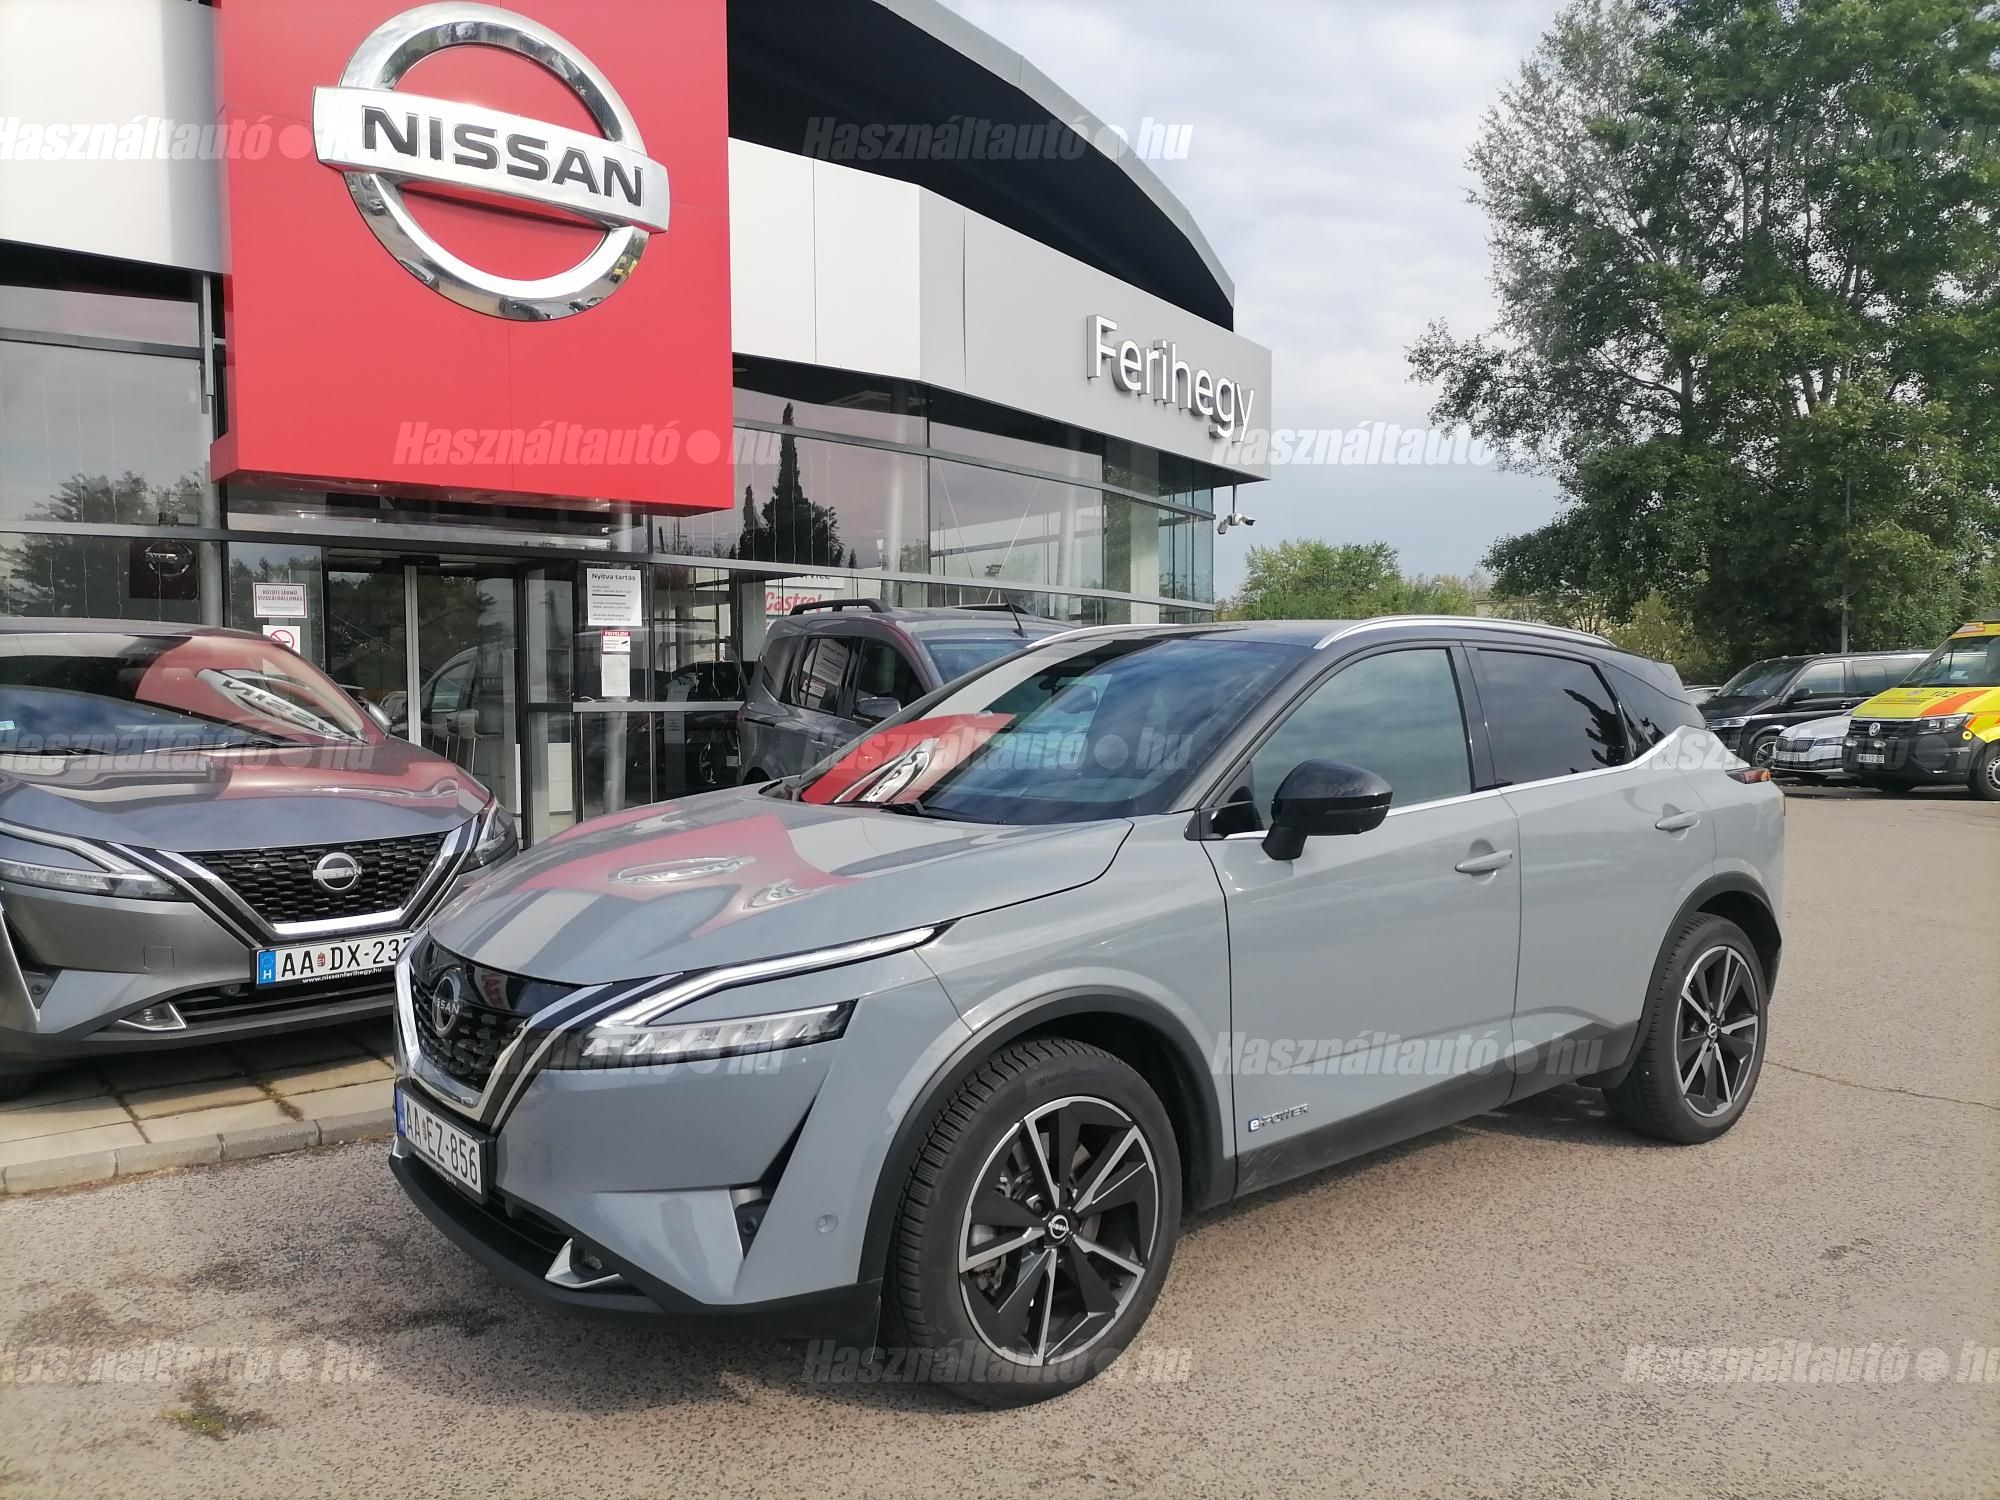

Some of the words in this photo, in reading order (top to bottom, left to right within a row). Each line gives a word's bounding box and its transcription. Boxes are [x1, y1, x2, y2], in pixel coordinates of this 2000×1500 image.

[361, 105, 645, 207] NISSAN
[1087, 314, 1255, 443] Ferihegy
[591, 573, 614, 581] Nyitva
[765, 592, 823, 613] Castrol
[329, 937, 412, 970] DX-23
[302, 967, 383, 984] www.nissanferihegy.hu
[425, 1116, 478, 1186] EZ-856
